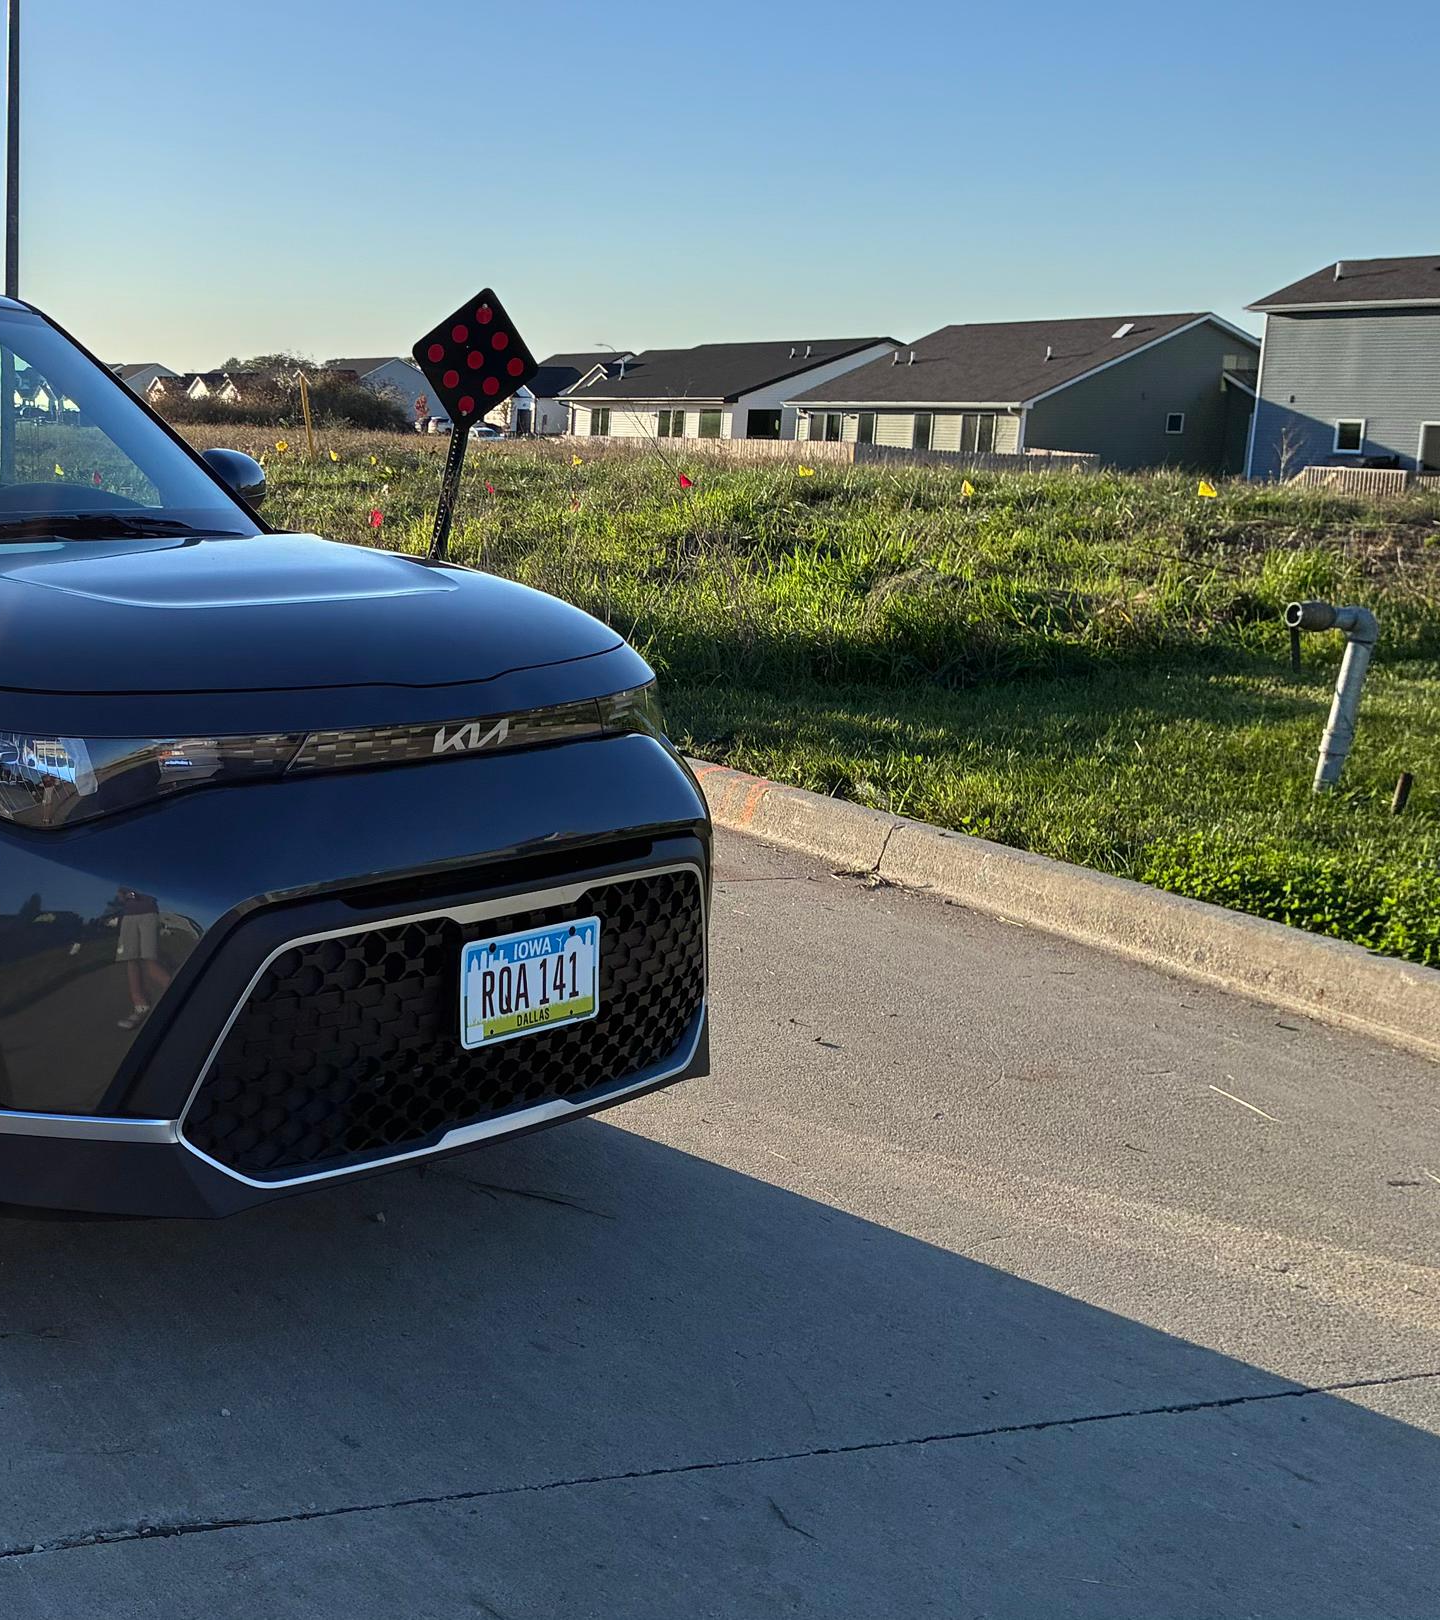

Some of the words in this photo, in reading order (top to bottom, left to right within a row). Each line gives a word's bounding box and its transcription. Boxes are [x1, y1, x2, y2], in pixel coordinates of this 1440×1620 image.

[433, 719, 509, 753] KIA
[514, 936, 552, 961] IOWA
[482, 963, 530, 1019] RQA
[539, 951, 580, 1006] 141
[516, 1007, 550, 1027] DALLAS
